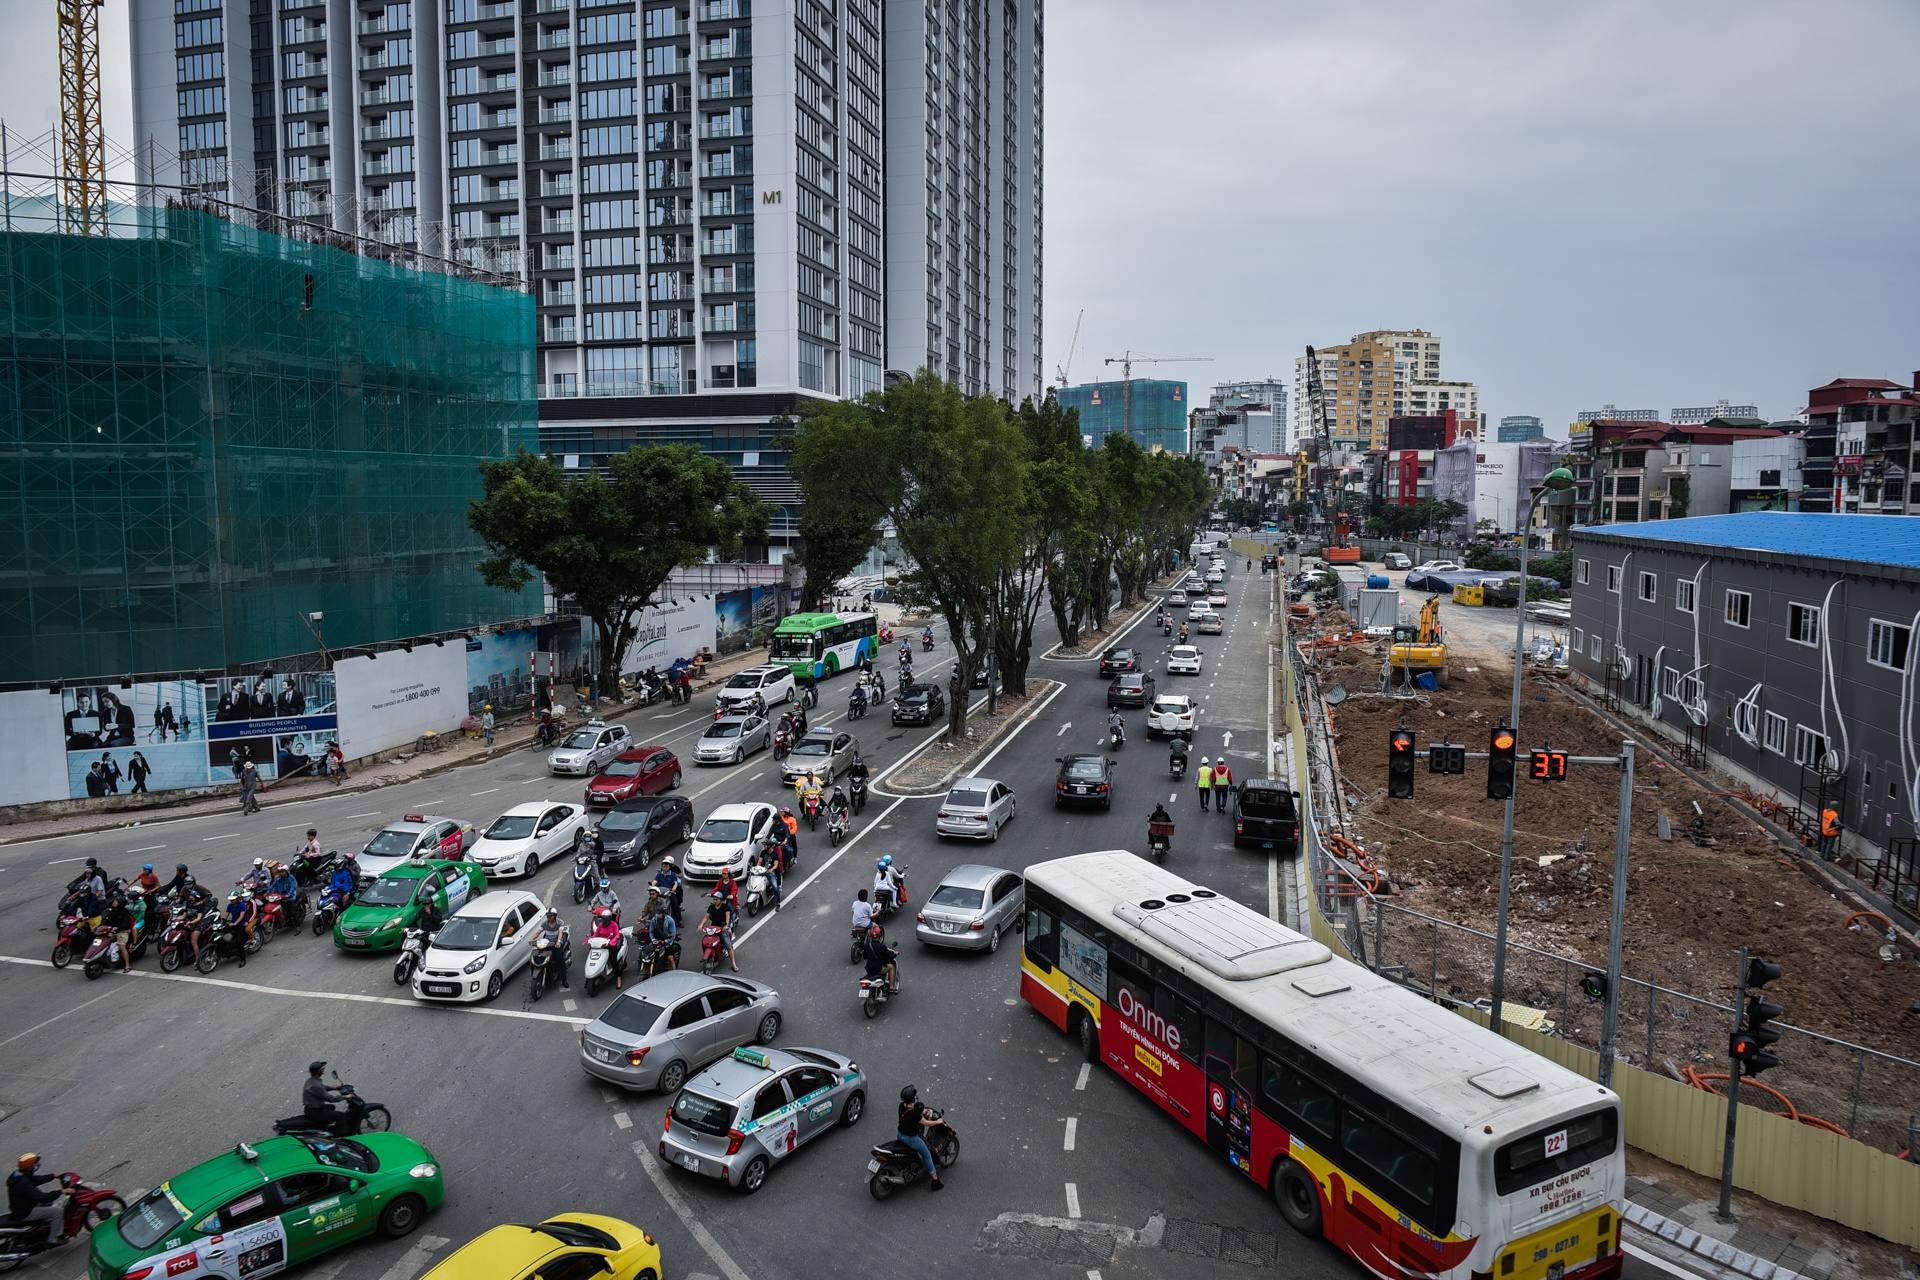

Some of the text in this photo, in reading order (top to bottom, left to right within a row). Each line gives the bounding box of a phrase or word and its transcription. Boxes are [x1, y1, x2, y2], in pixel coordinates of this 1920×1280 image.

[762, 190, 781, 204] M1
[656, 608, 677, 617] collaboration
[636, 623, 667, 643] CapitaLand
[636, 650, 669, 662] BUILDING PEOPLE
[405, 692, 419, 702] 1800
[419, 689, 430, 697] 400
[430, 686, 441, 695] 099
[240, 725, 308, 736] BUILDING COMMUNITIES
[1535, 753, 1564, 777] 37
[1118, 987, 1181, 1050] Onme
[1120, 1020, 1180, 1070] TRUYỀN HÌNH DI ĐỘNG
[1136, 1048, 1150, 1065] MIỄN
[1151, 1060, 1161, 1073] PHÍ
[1210, 1111, 1224, 1127] Onme
[1542, 1181, 1555, 1193] BUS
[1553, 1187, 1576, 1200] Hotline
[1540, 1190, 1582, 1213] 1900 1296
[250, 1229, 280, 1248] S6500
[1398, 1212, 1411, 1230] 29B
[1418, 1228, 1444, 1253] 027.91
[1533, 1247, 1548, 1262] 29B
[1555, 1234, 1579, 1253] 027.91
[169, 1258, 194, 1271] TCL
